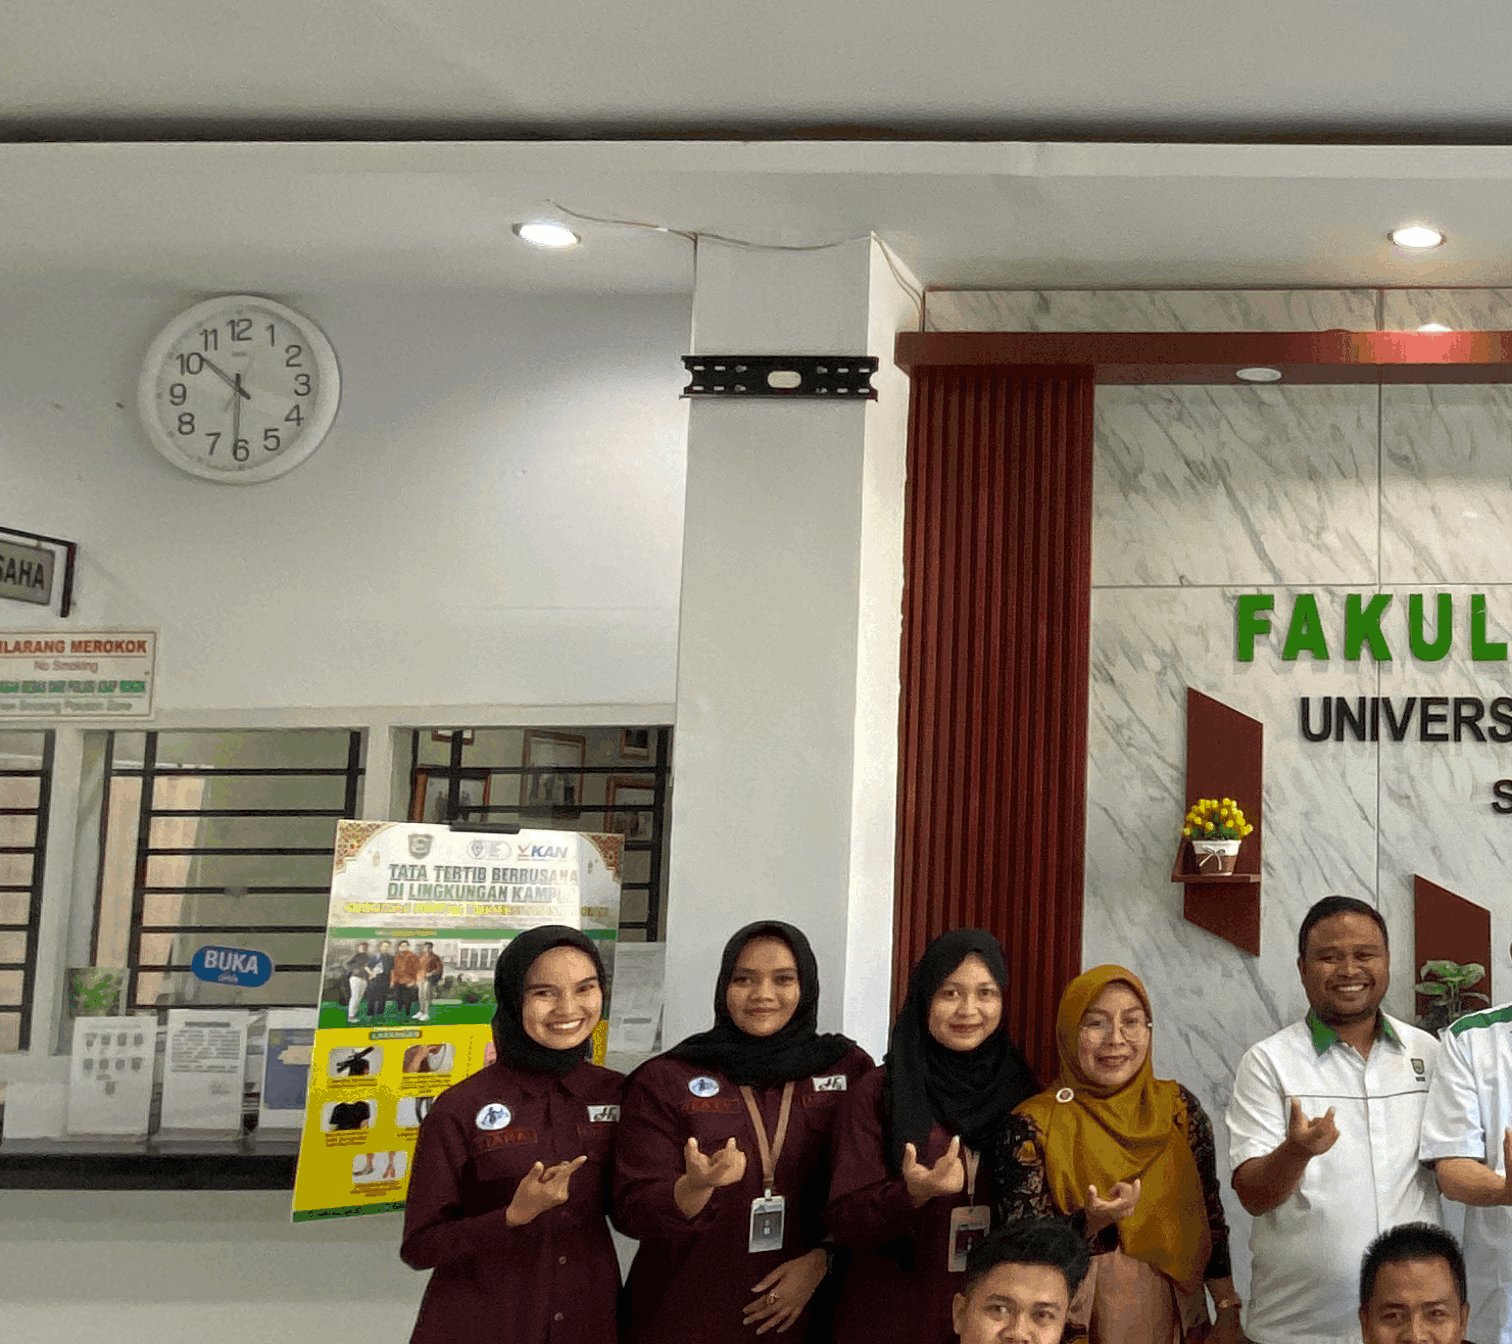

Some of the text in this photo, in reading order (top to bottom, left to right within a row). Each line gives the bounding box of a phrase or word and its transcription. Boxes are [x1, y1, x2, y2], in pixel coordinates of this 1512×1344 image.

[199, 328, 219, 352] 11
[226, 319, 253, 342] 12
[266, 324, 276, 347] 1
[176, 352, 204, 376] 10
[285, 345, 302, 368] 2
[169, 383, 187, 406] 9
[294, 374, 311, 396] 3
[177, 413, 195, 435] 8
[284, 404, 304, 427] 4
[205, 432, 221, 456] 7
[233, 439, 250, 462] 6
[263, 428, 280, 451] 5
[70, 640, 147, 654] MEROKOK
[34, 660, 50, 671] No
[388, 864, 428, 882] TATA
[434, 865, 487, 884] TERTIB
[387, 883, 404, 901] DI
[408, 883, 508, 902] LINGKUNGAN
[203, 949, 259, 975] BUKA
